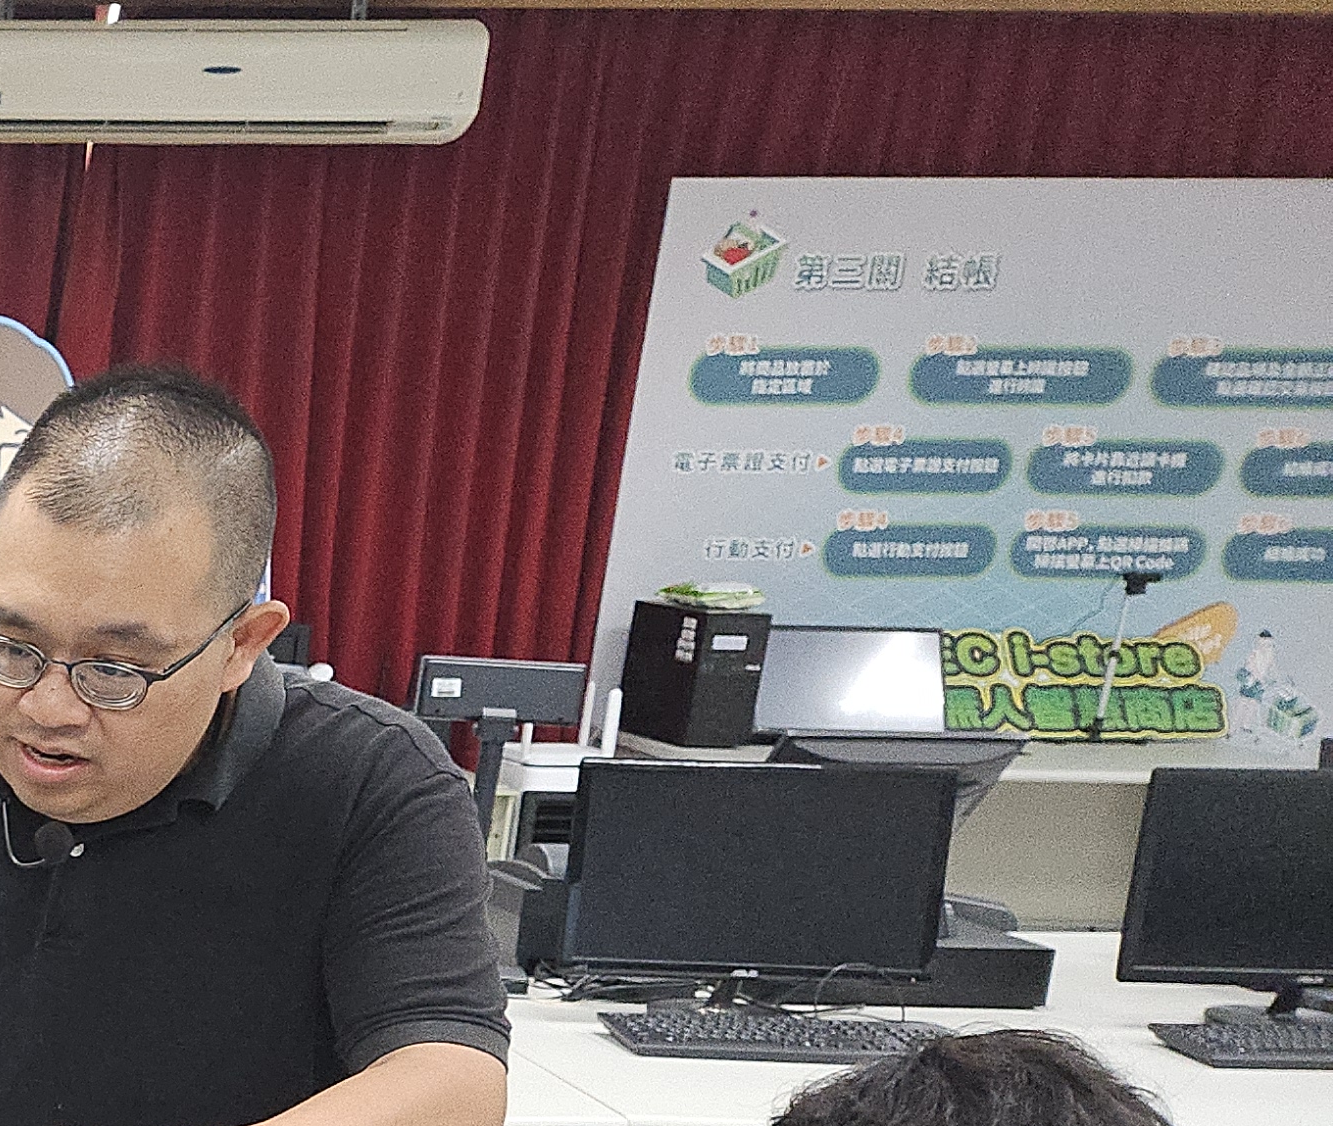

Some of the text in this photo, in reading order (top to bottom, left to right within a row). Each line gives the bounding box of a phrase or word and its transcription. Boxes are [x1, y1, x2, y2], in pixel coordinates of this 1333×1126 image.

[794, 254, 999, 290] 第三關 結帳
[673, 451, 813, 473] 電子票證支付
[703, 538, 796, 560] 行動支付
